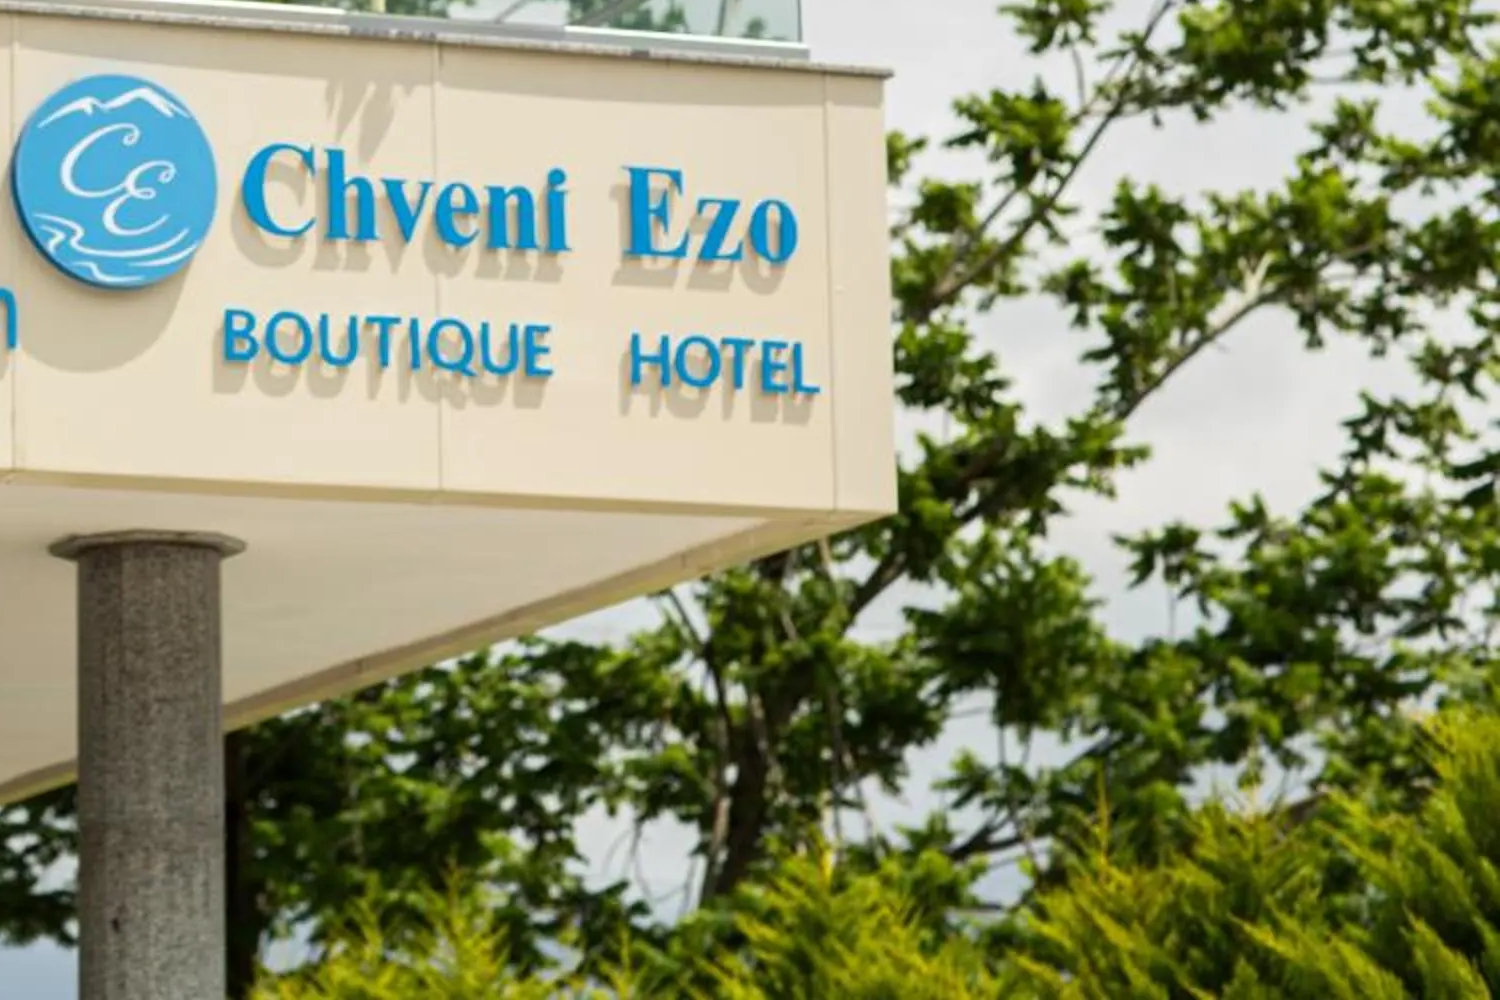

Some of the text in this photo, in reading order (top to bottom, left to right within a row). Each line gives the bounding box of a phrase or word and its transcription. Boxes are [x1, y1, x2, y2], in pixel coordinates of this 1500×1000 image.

[241, 143, 799, 264] Chveni Ezo
[222, 308, 821, 394] BOUTIQUE HOTEL
